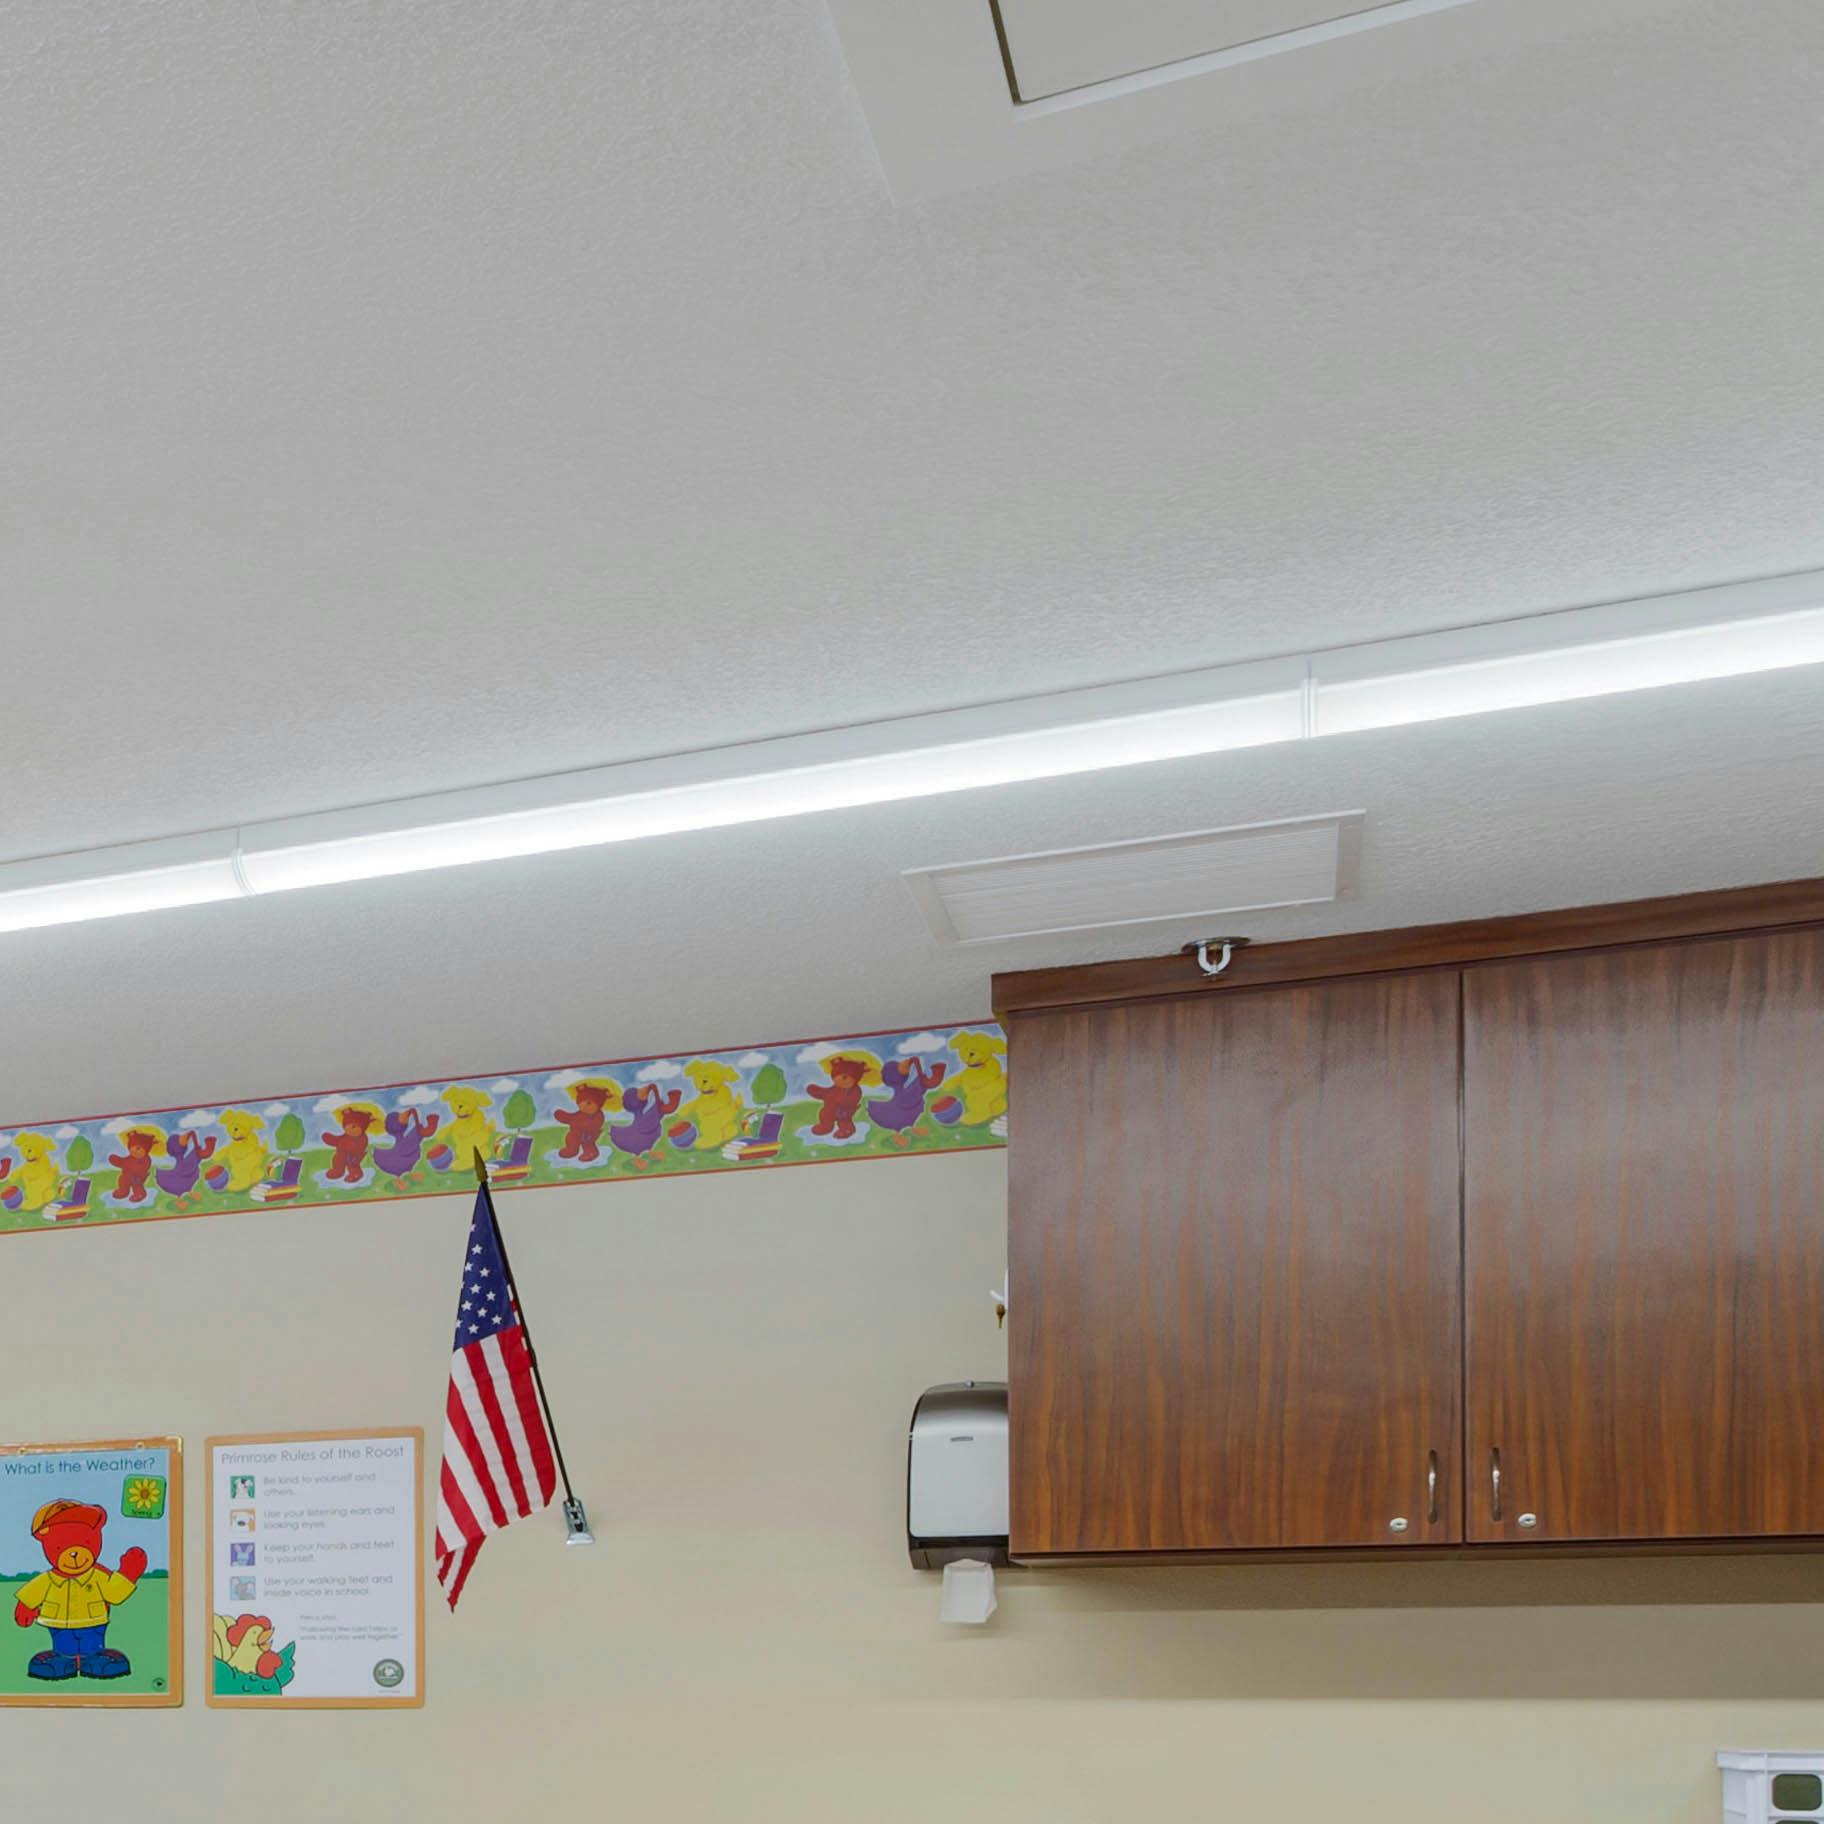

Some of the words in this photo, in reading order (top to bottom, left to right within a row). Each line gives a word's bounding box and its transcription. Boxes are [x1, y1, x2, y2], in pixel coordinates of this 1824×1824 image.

[221, 1452, 277, 1465] Primrose
[280, 1449, 316, 1462] Rules
[320, 1447, 335, 1460] of
[338, 1447, 361, 1459] the
[365, 1446, 404, 1458] Roost
[4, 1462, 42, 1475] What
[46, 1462, 55, 1474] is
[59, 1461, 82, 1473] the
[85, 1457, 156, 1472] Weather?
